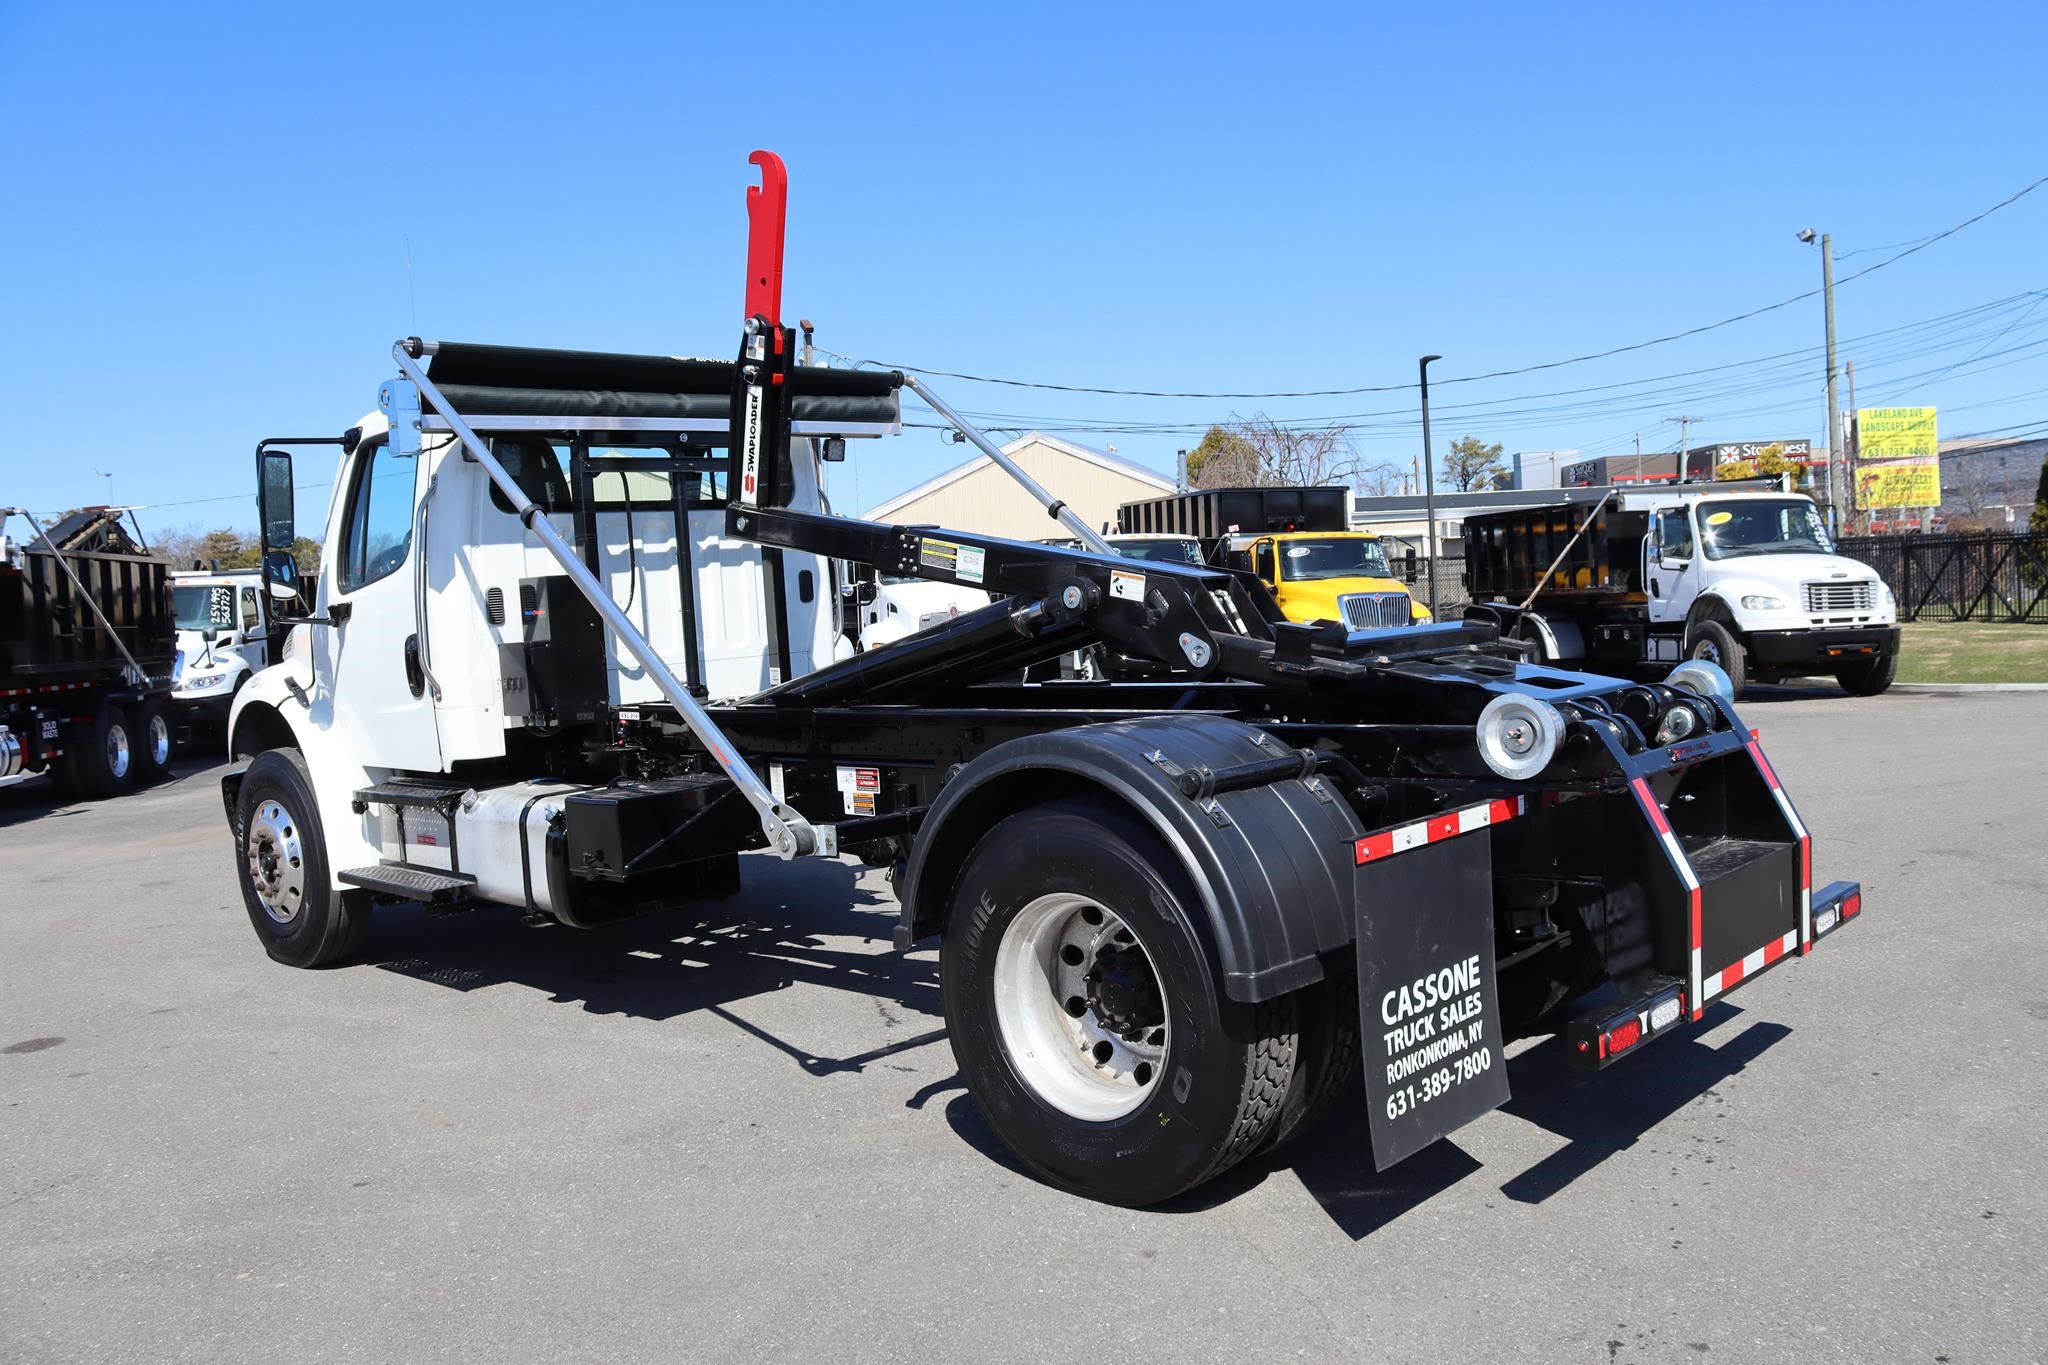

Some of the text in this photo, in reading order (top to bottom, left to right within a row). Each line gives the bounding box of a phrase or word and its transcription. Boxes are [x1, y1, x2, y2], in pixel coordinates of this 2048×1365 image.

[747, 395, 759, 472] SWAPLOADER
[1861, 421, 1905, 432] LANDSCAPE
[1869, 408, 1924, 419] LAKELAND AVE
[221, 588, 231, 624] 563727
[1381, 955, 1481, 1026] CASSONE
[1383, 991, 1483, 1056] TRUCK SALES
[1386, 1019, 1484, 1085] RONKONKOMA, NY
[1386, 1046, 1491, 1120] 631-389-7800
